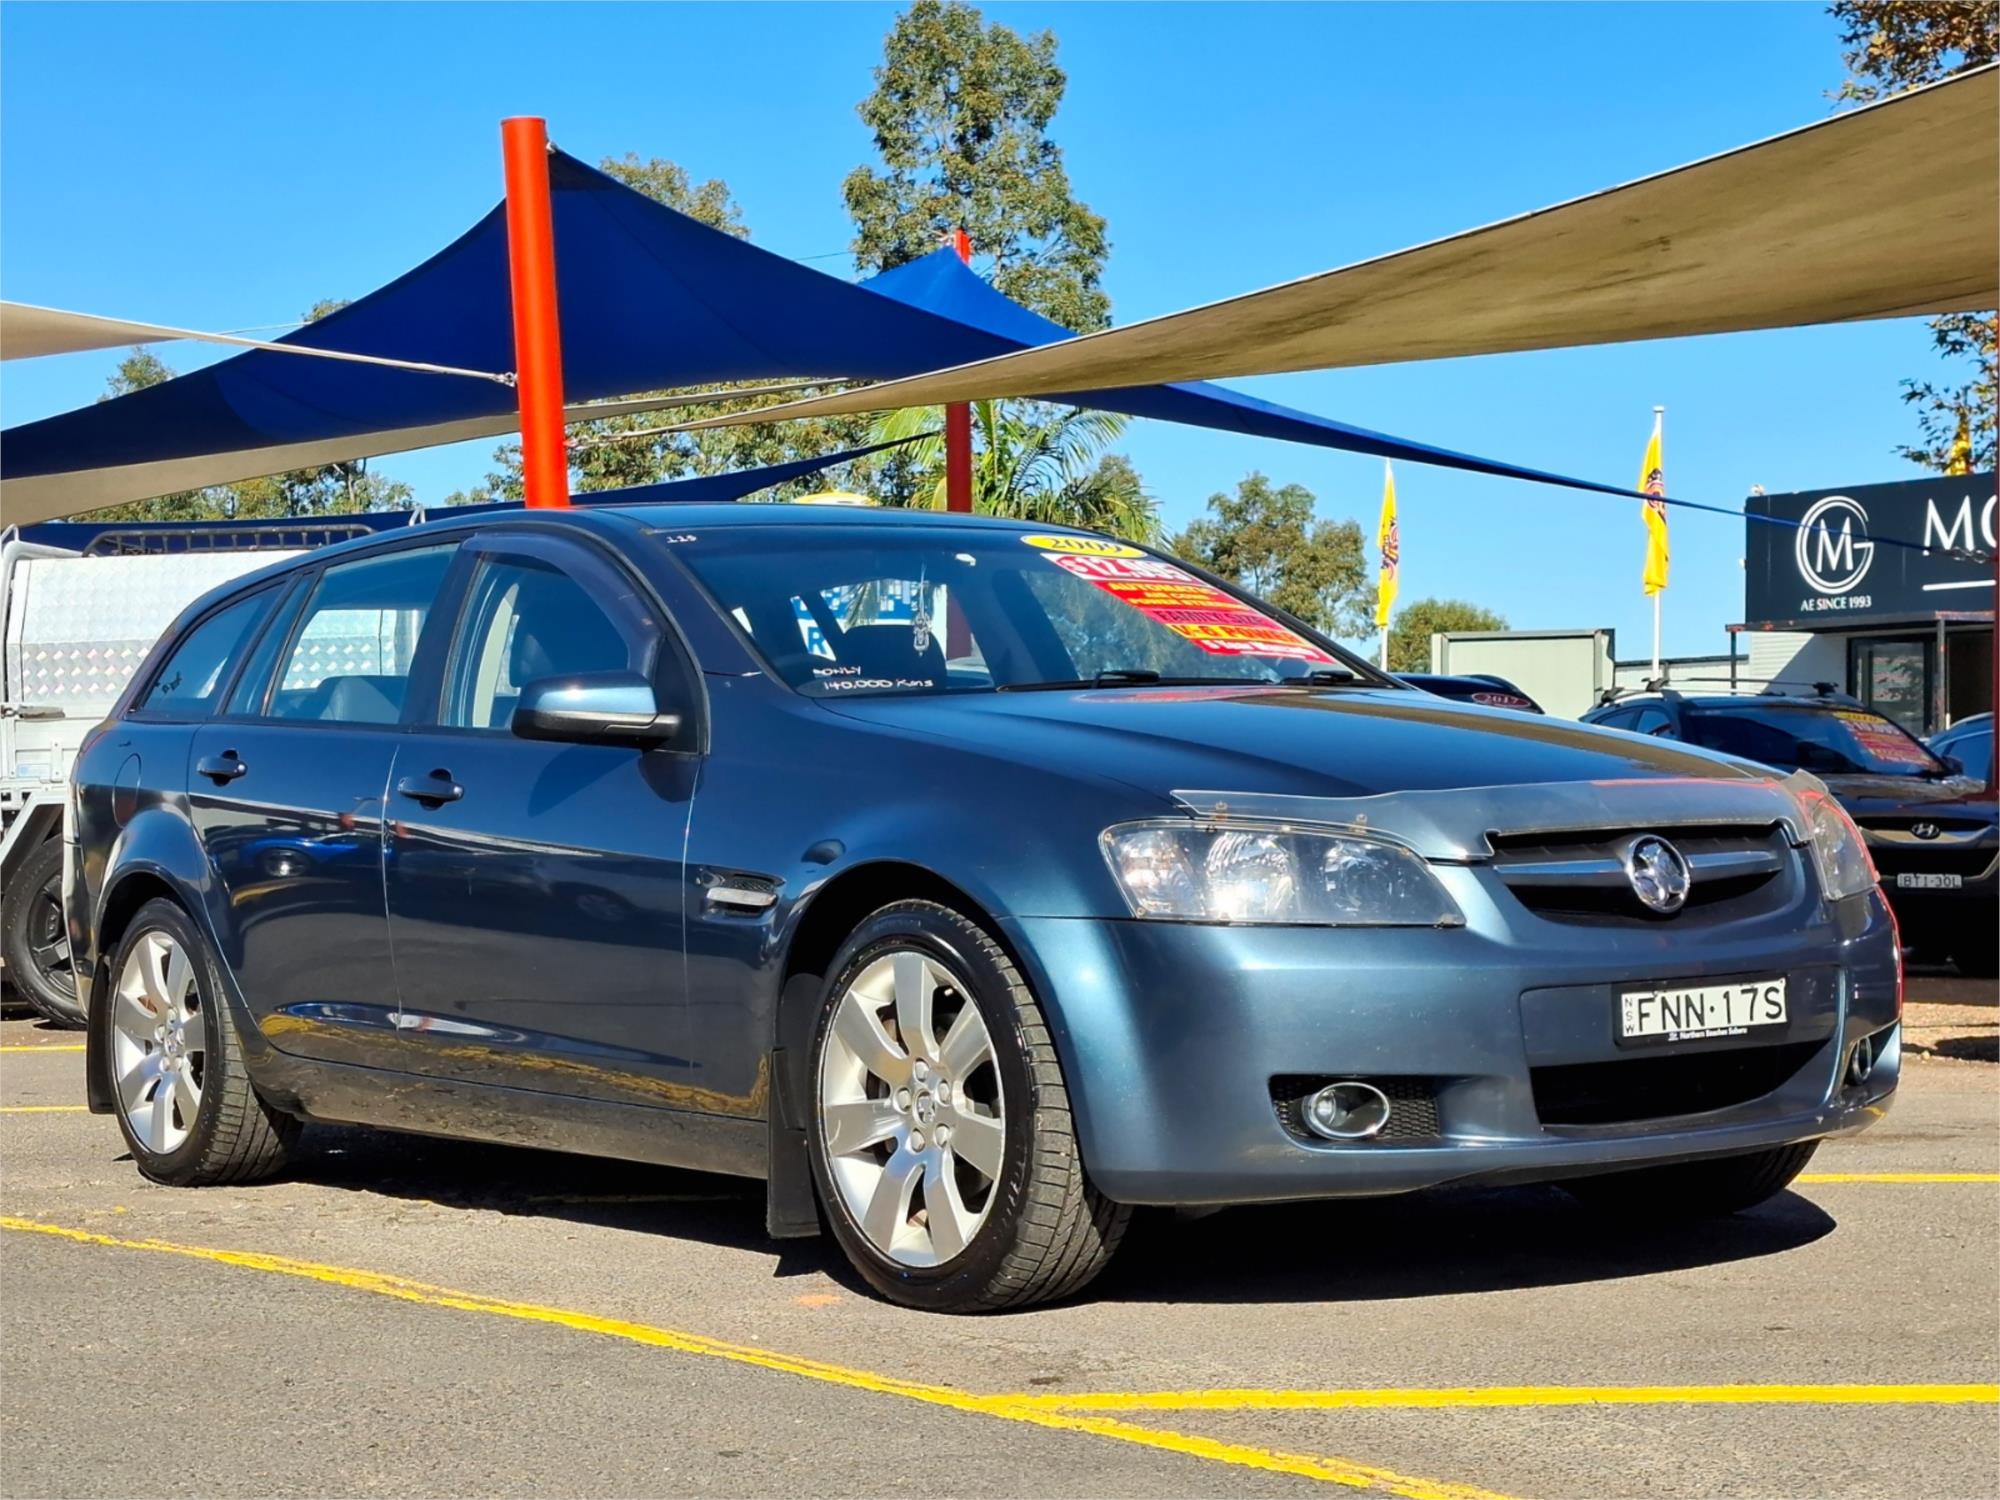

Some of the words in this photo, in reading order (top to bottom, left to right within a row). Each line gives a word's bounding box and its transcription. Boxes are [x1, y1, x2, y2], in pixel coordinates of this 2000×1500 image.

[1051, 538, 1123, 552] 2009
[1801, 600, 1815, 612] AE
[1816, 598, 1848, 610] SINCE
[1849, 596, 1872, 609] 1993
[1152, 610, 1225, 624] FAMILY
[1172, 625, 1219, 637] V-6
